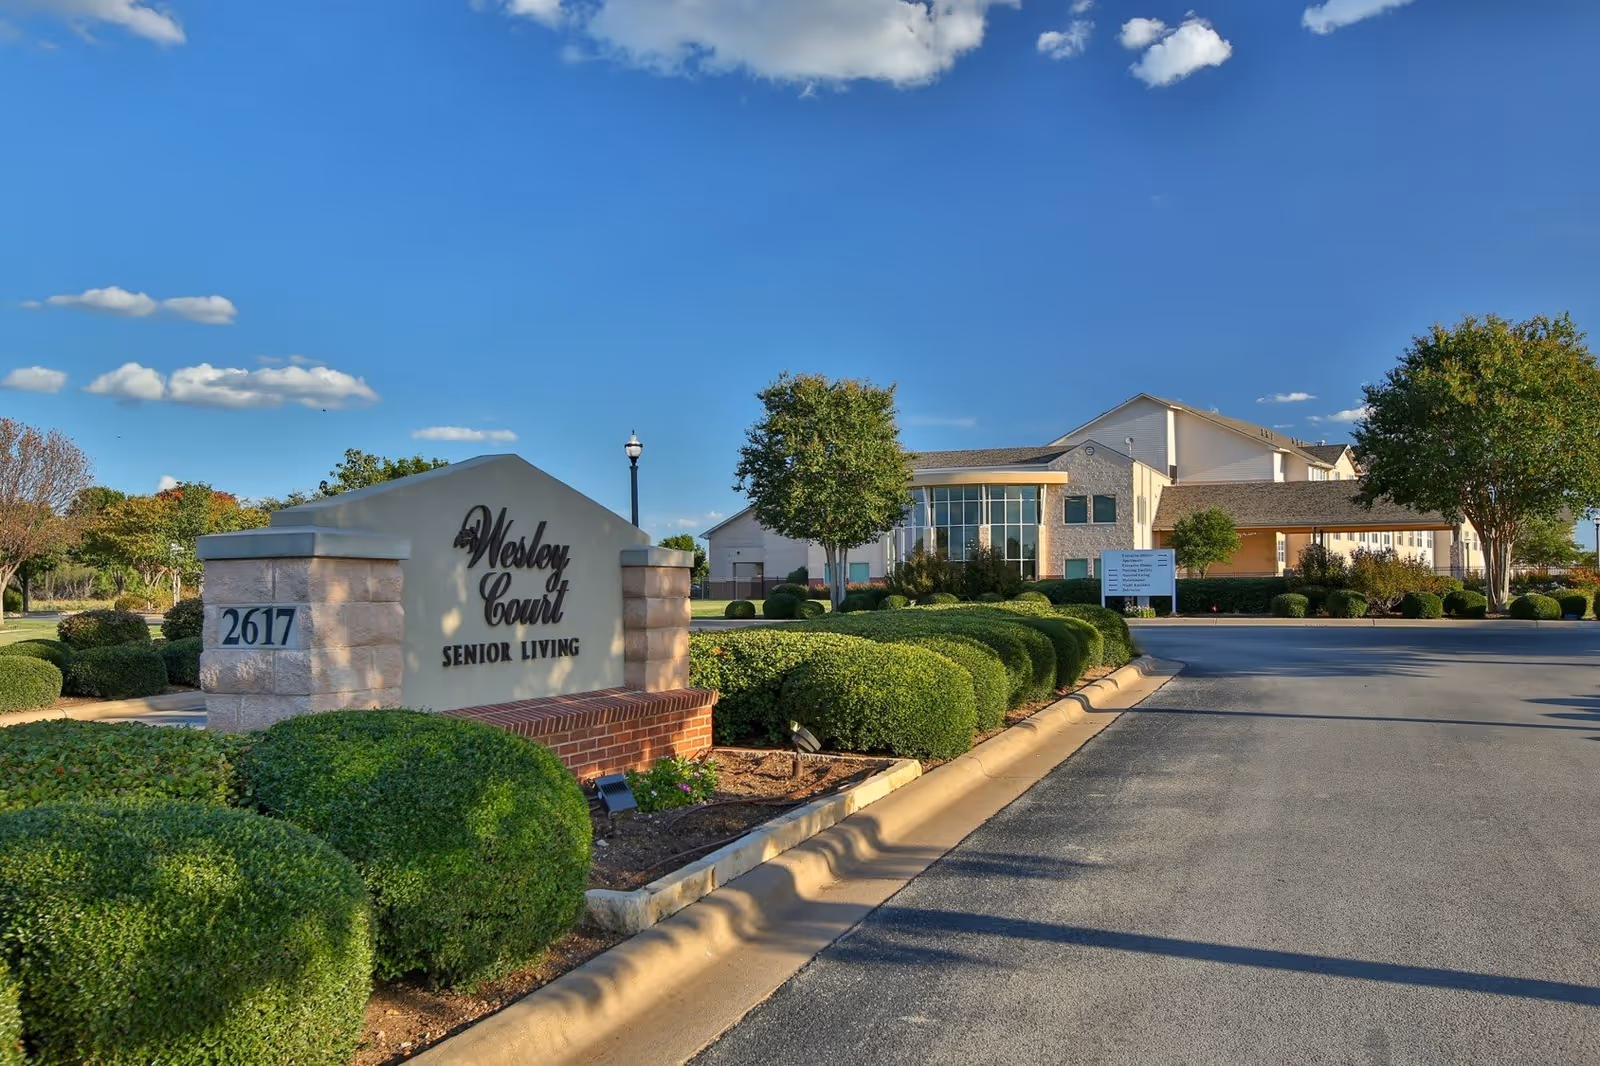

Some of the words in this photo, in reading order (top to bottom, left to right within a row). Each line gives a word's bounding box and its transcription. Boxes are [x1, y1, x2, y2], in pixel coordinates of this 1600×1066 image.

[454, 505, 570, 593] Wesley
[479, 571, 570, 627] Court
[222, 608, 296, 645] 2617
[442, 642, 512, 667] SENIOR
[521, 637, 580, 660] LIVING
